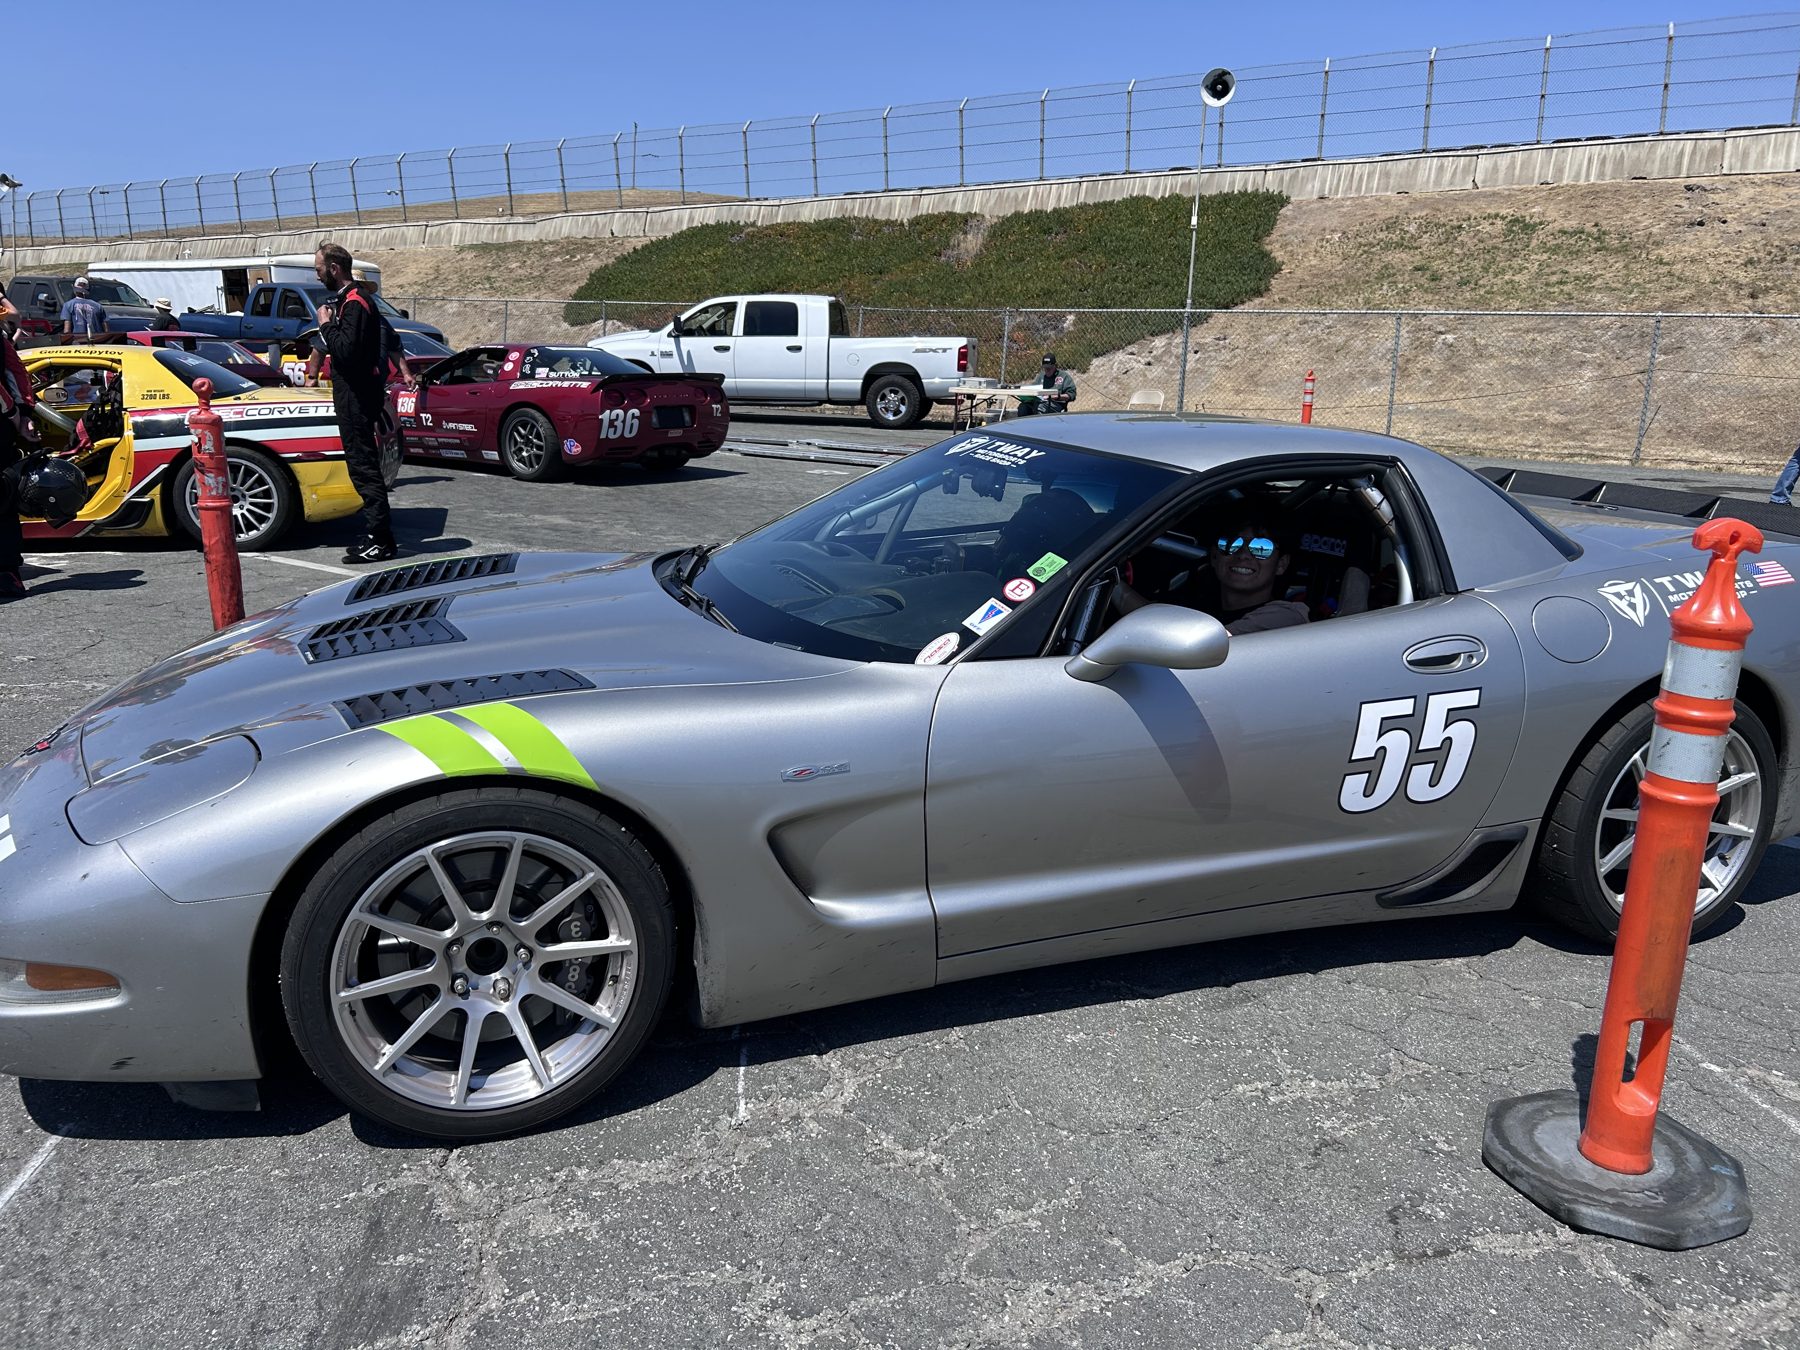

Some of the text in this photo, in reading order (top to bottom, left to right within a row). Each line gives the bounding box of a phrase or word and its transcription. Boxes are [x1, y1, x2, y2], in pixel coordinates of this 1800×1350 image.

[282, 362, 307, 387] 56
[141, 393, 158, 401] 3200
[397, 397, 416, 413] 136
[245, 405, 335, 417] CORVETT
[711, 404, 722, 417] T2
[419, 413, 434, 427] T2
[598, 408, 641, 440] 136
[986, 441, 1047, 460] TWAY
[1008, 580, 1030, 597] E
[969, 622, 983, 631] OFF
[1338, 686, 1482, 815] 55
